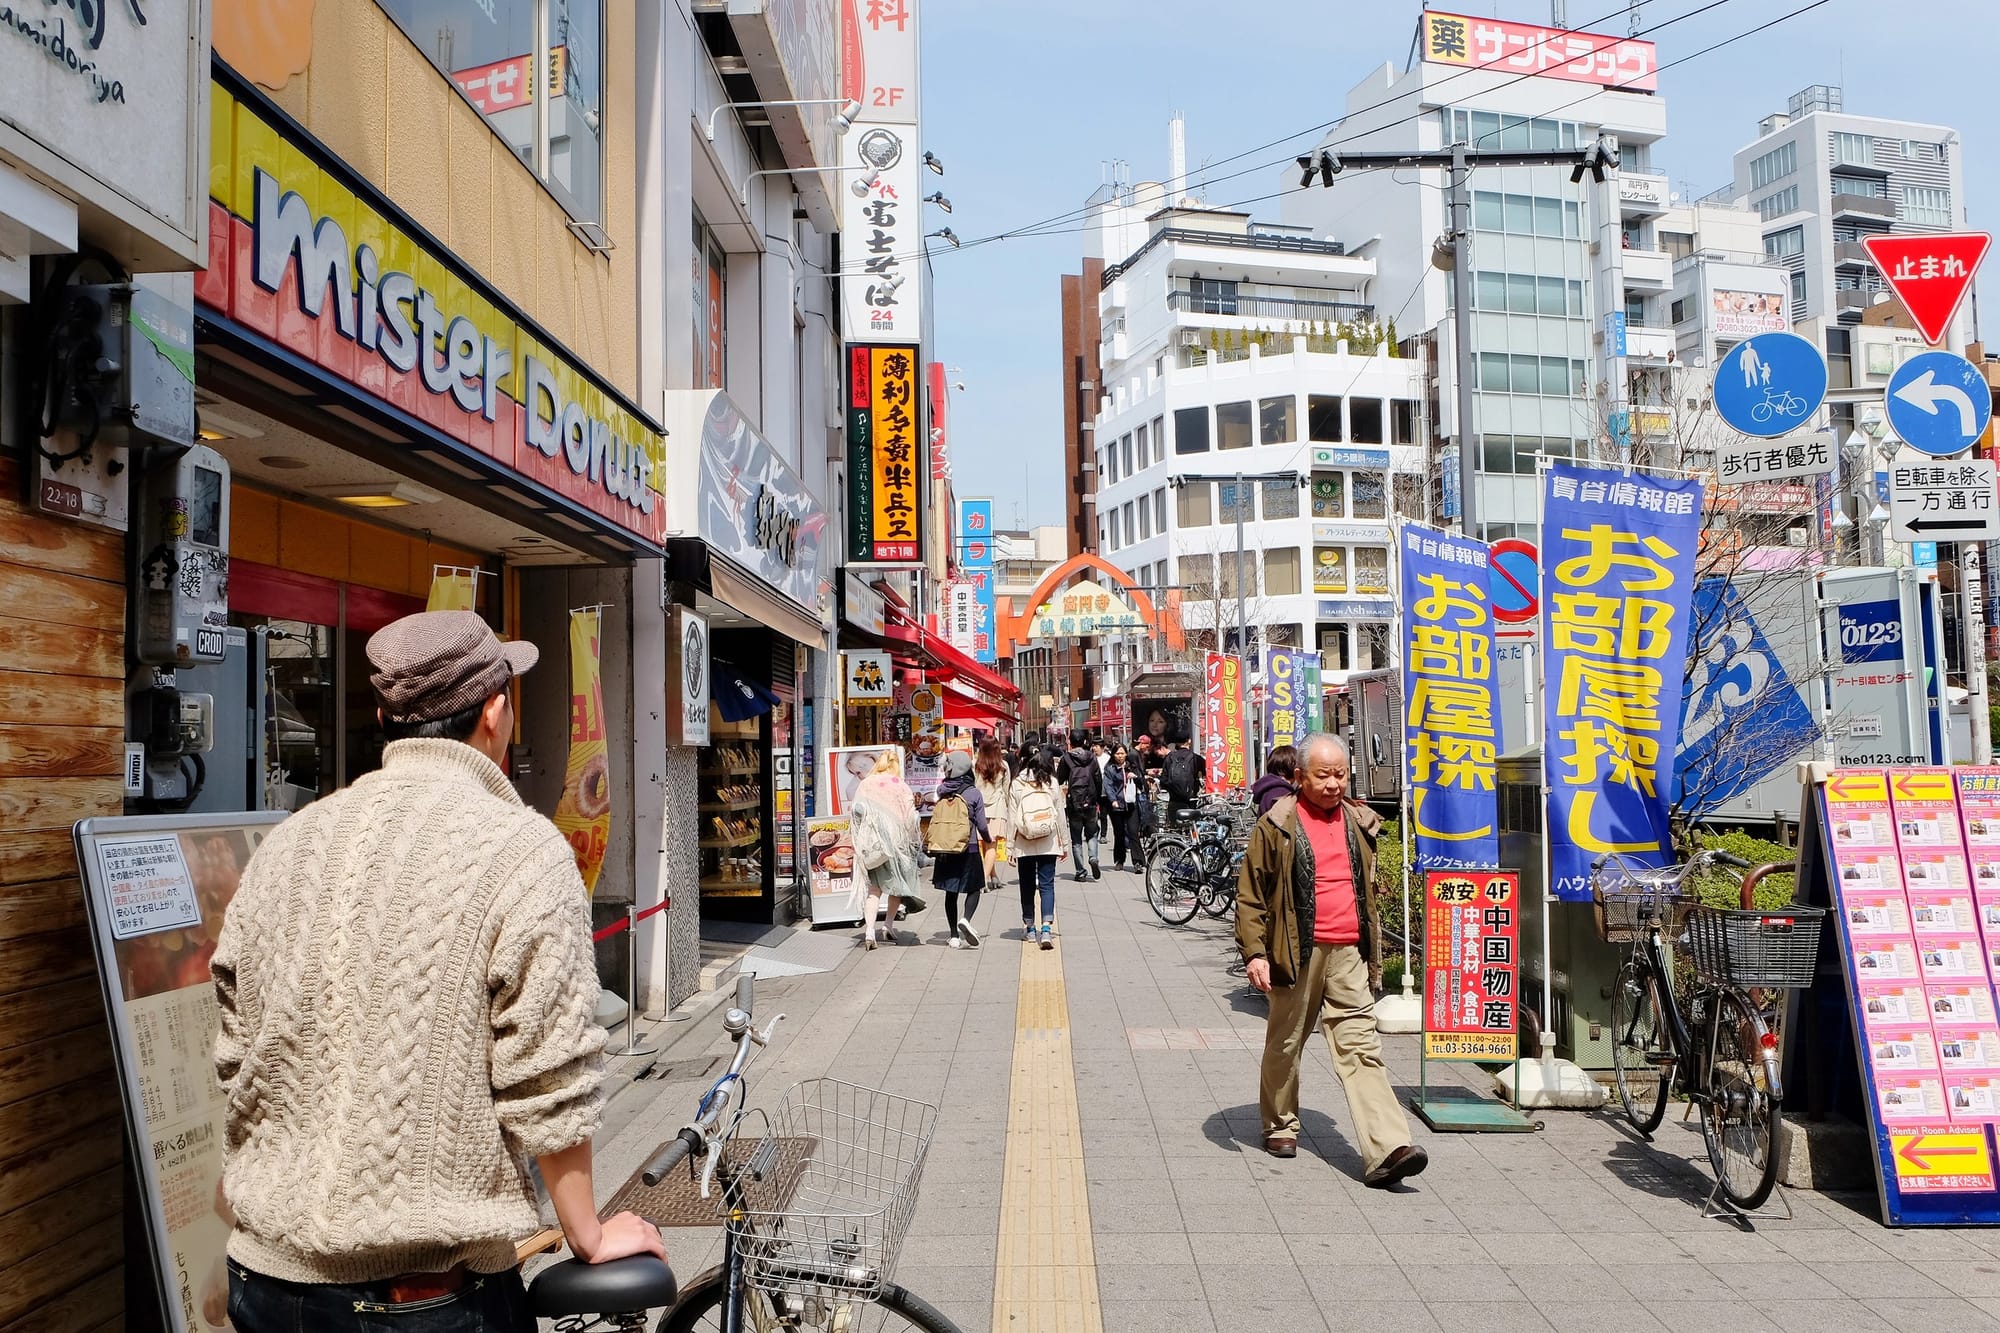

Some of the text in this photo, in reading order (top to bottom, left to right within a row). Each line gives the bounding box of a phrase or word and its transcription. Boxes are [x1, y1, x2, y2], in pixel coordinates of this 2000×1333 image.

[1432, 18, 1649, 80] 薬 サンドラッグ
[872, 87, 904, 107] 2F
[1620, 189, 1659, 202] センタービル
[1893, 254, 1967, 280] 止まれ
[871, 310, 893, 320] 24
[870, 321, 893, 331] 時間
[252, 165, 656, 516] Mister Donut
[1722, 442, 1828, 477] 歩行者優先
[1896, 466, 1990, 488] 自転車を除く
[47, 487, 78, 508] 22-18
[1552, 476, 1695, 515] 賃貸情報館
[1897, 490, 1991, 512] 一方通行
[876, 546, 913, 557] 地下1階
[1407, 531, 1487, 569] 賃貸情報館
[968, 512, 990, 650] カラオ館
[1063, 593, 1110, 613] 高円寺
[1344, 605, 1366, 615] Ash
[1841, 617, 1857, 626] the
[198, 631, 222, 654] CROD
[1842, 620, 1901, 647] 0123
[858, 660, 879, 671] 天丼
[852, 676, 885, 691] てんや
[1551, 524, 1680, 853] お部屋探し
[1836, 673, 1914, 687] アート引越センター
[1407, 572, 1496, 842] お部屋探し
[1207, 661, 1226, 783] インターネット
[1840, 754, 1925, 766] the0123.com
[131, 754, 142, 788] KOUME
[833, 878, 849, 890] 720
[1437, 882, 1509, 901] 激安 4F
[1462, 906, 1480, 1025] 中華食材・食品
[1482, 904, 1512, 1029] 中国物産
[1432, 1043, 1512, 1055] TEL:03-5364-9661
[1892, 1125, 1980, 1135] Rental Room Adviser
[1901, 1175, 1991, 1189] お気軽にご来店ください。
